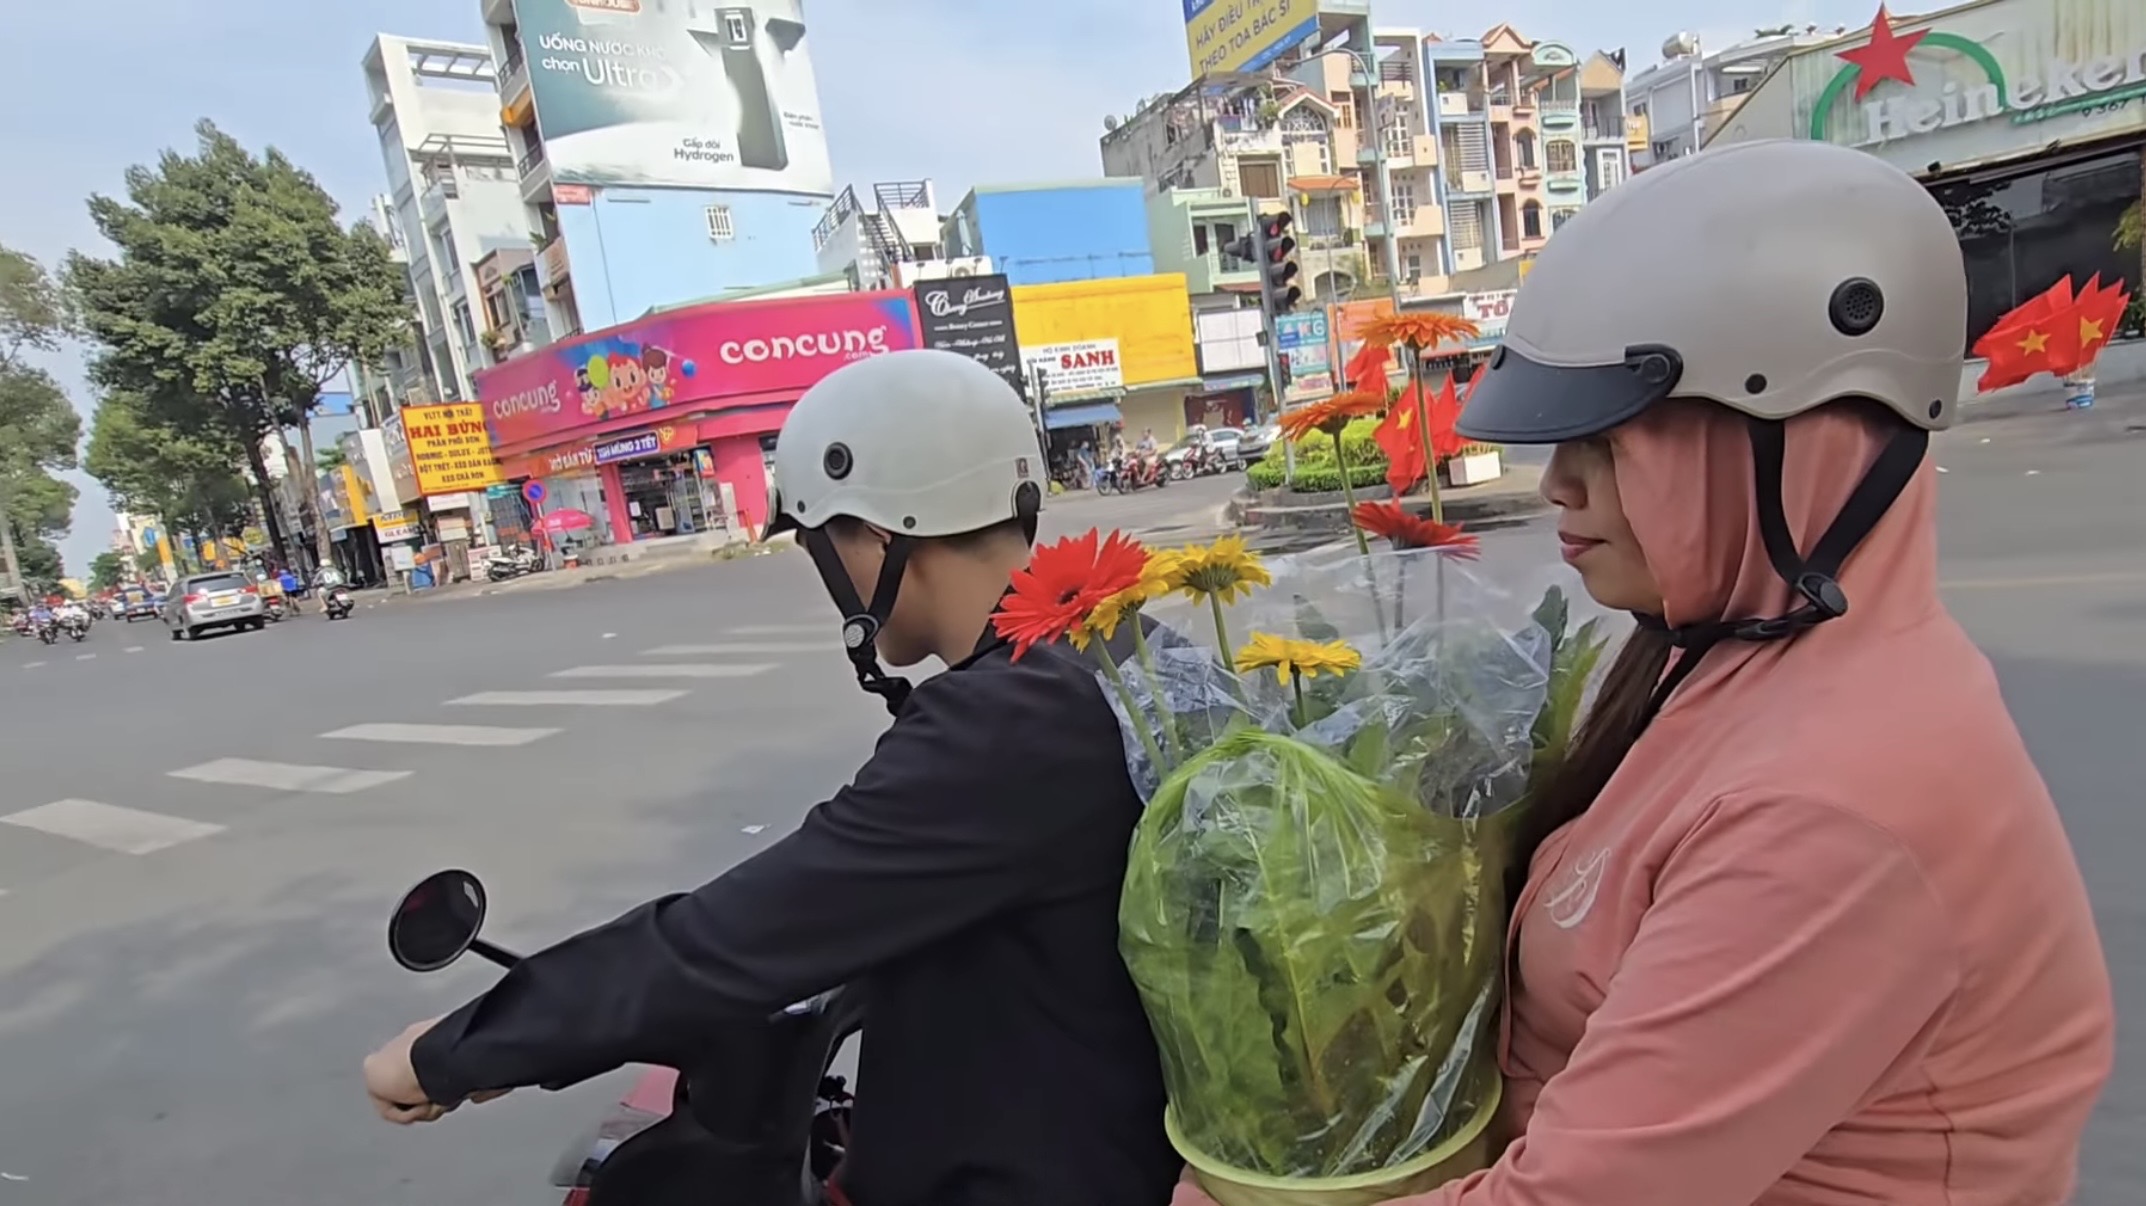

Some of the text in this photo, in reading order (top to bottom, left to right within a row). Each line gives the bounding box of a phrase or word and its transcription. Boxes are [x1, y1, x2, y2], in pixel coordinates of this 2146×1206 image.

[1218, 5, 1243, 32] ĐIỀU
[539, 32, 586, 52] UỐNG
[1200, 45, 1227, 74] THEO
[541, 57, 659, 89] chọn Ultra
[683, 137, 703, 149] Gấp
[674, 148, 734, 163] Hydrogen
[720, 325, 889, 364] concung
[1061, 350, 1115, 369] SANH
[493, 380, 561, 418] concung
[409, 424, 442, 439] HAI
